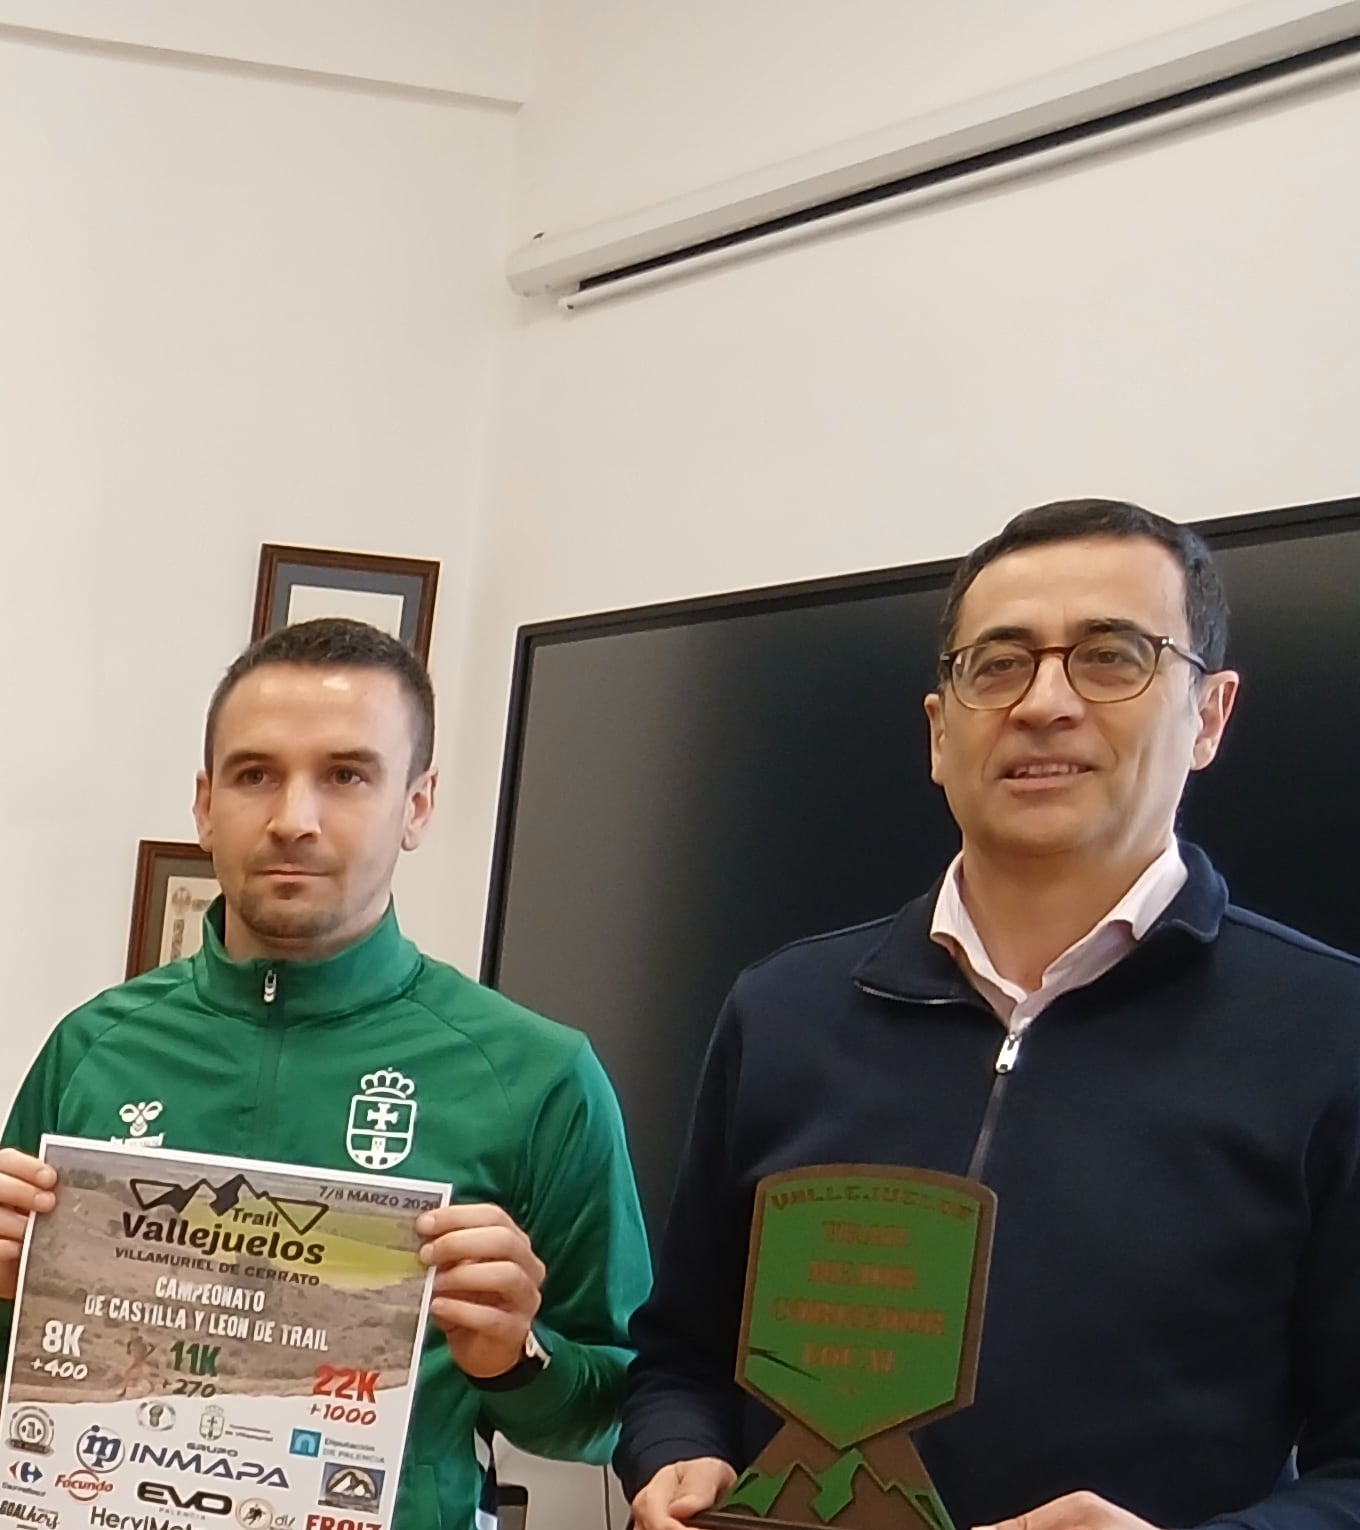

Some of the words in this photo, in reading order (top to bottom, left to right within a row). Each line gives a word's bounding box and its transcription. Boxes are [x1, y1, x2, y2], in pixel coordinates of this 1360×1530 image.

[347, 1190, 399, 1208] MARZO
[230, 1206, 279, 1229] Trail
[122, 1211, 325, 1265] Vallejuelos
[114, 1247, 215, 1273] VILLAMURIEL
[218, 1261, 240, 1276] DE
[244, 1264, 321, 1287] CERRATO
[155, 1276, 265, 1313] CAMPEONATO
[41, 1320, 85, 1358] 8K
[84, 1294, 105, 1317] DE
[109, 1298, 187, 1330] CASTILLA
[193, 1311, 205, 1333] Y
[253, 1318, 275, 1343] DE
[282, 1323, 330, 1352] TRAIL
[30, 1356, 88, 1381] +400
[170, 1340, 222, 1378] 11K
[162, 1377, 217, 1399] +270
[312, 1363, 381, 1404] 22K
[309, 1403, 377, 1426] +1000
[129, 1442, 290, 1489] INMAPA
[186, 1441, 239, 1458] GRUPO
[54, 1474, 114, 1493] Facundo
[137, 1481, 233, 1516] EVO
